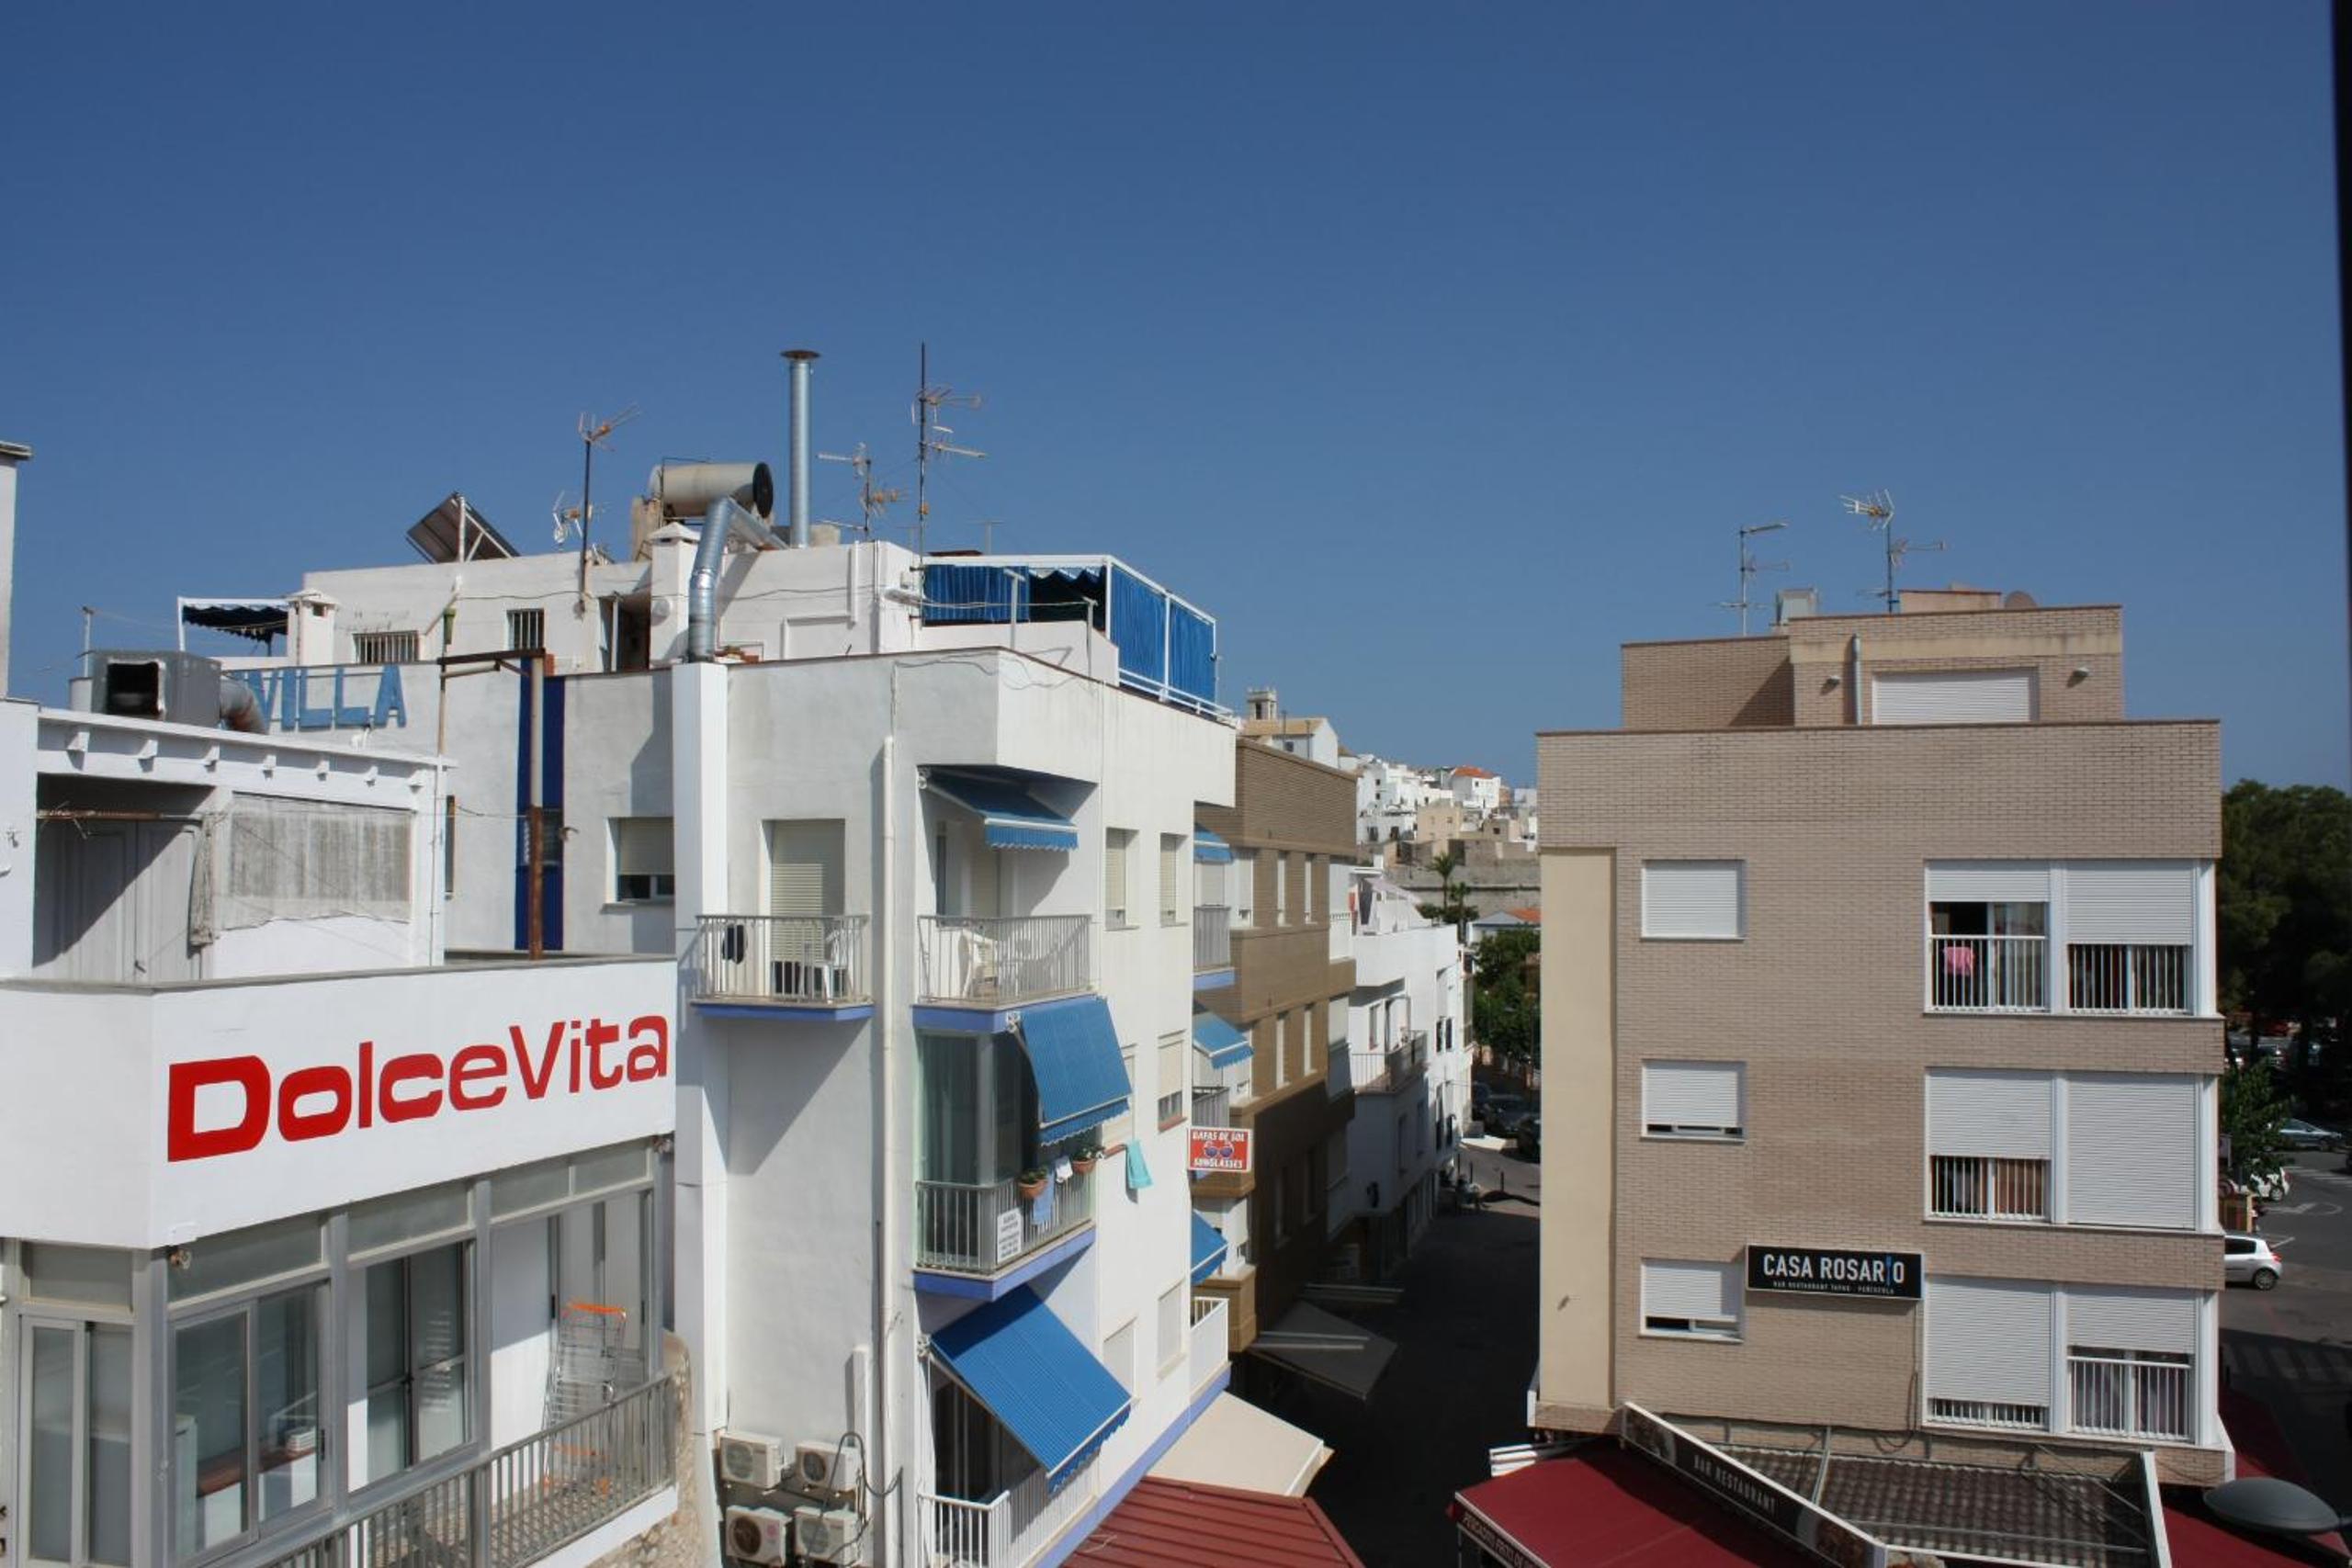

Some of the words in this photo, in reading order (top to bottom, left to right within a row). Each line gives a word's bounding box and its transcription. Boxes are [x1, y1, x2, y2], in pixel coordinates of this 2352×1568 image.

[168, 1015, 668, 1162] DolceVita
[1194, 1157, 1243, 1168] SUNGLASSES
[1763, 1254, 1814, 1278] CASA
[1694, 1454, 1712, 1476] BAR
[1715, 1466, 1777, 1517] RESTAURANT
